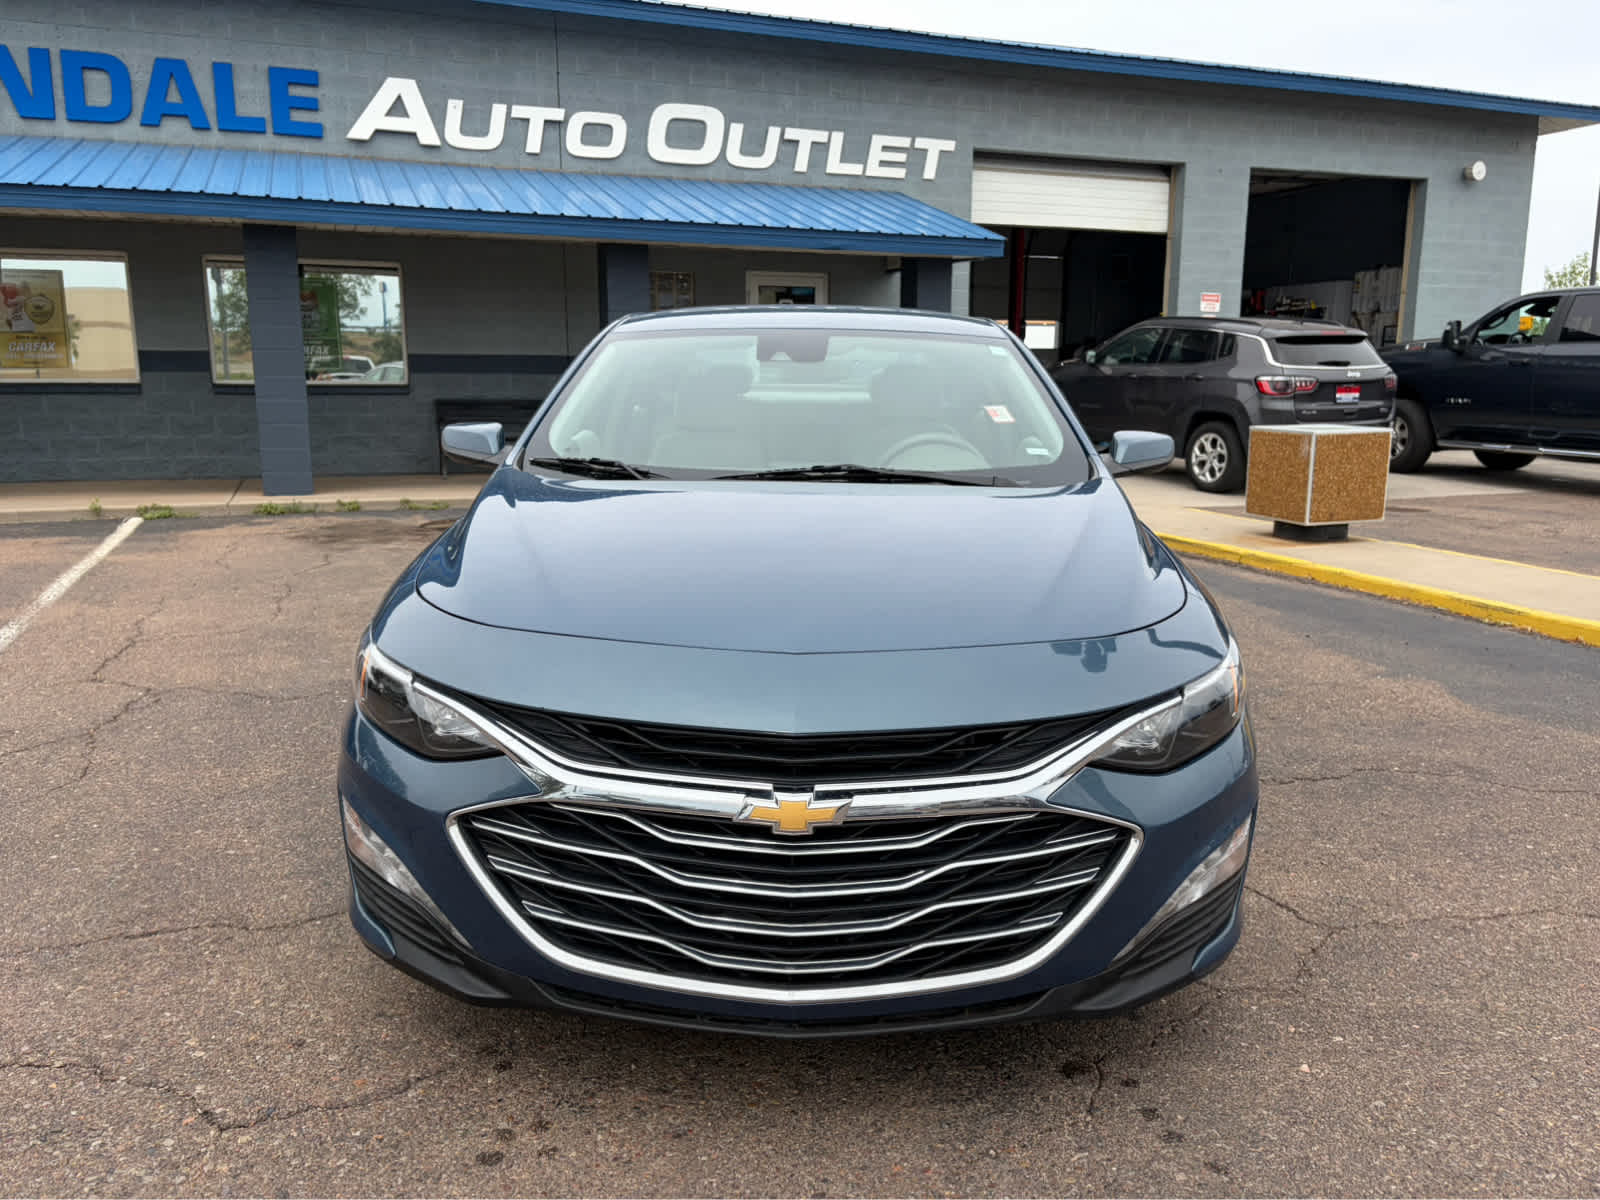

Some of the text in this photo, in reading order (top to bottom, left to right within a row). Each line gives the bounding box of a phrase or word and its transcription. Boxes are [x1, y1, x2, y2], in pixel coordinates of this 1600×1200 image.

[0, 44, 957, 180] NDALE AUTO OUTLET
[8, 341, 56, 352] CARFAX
